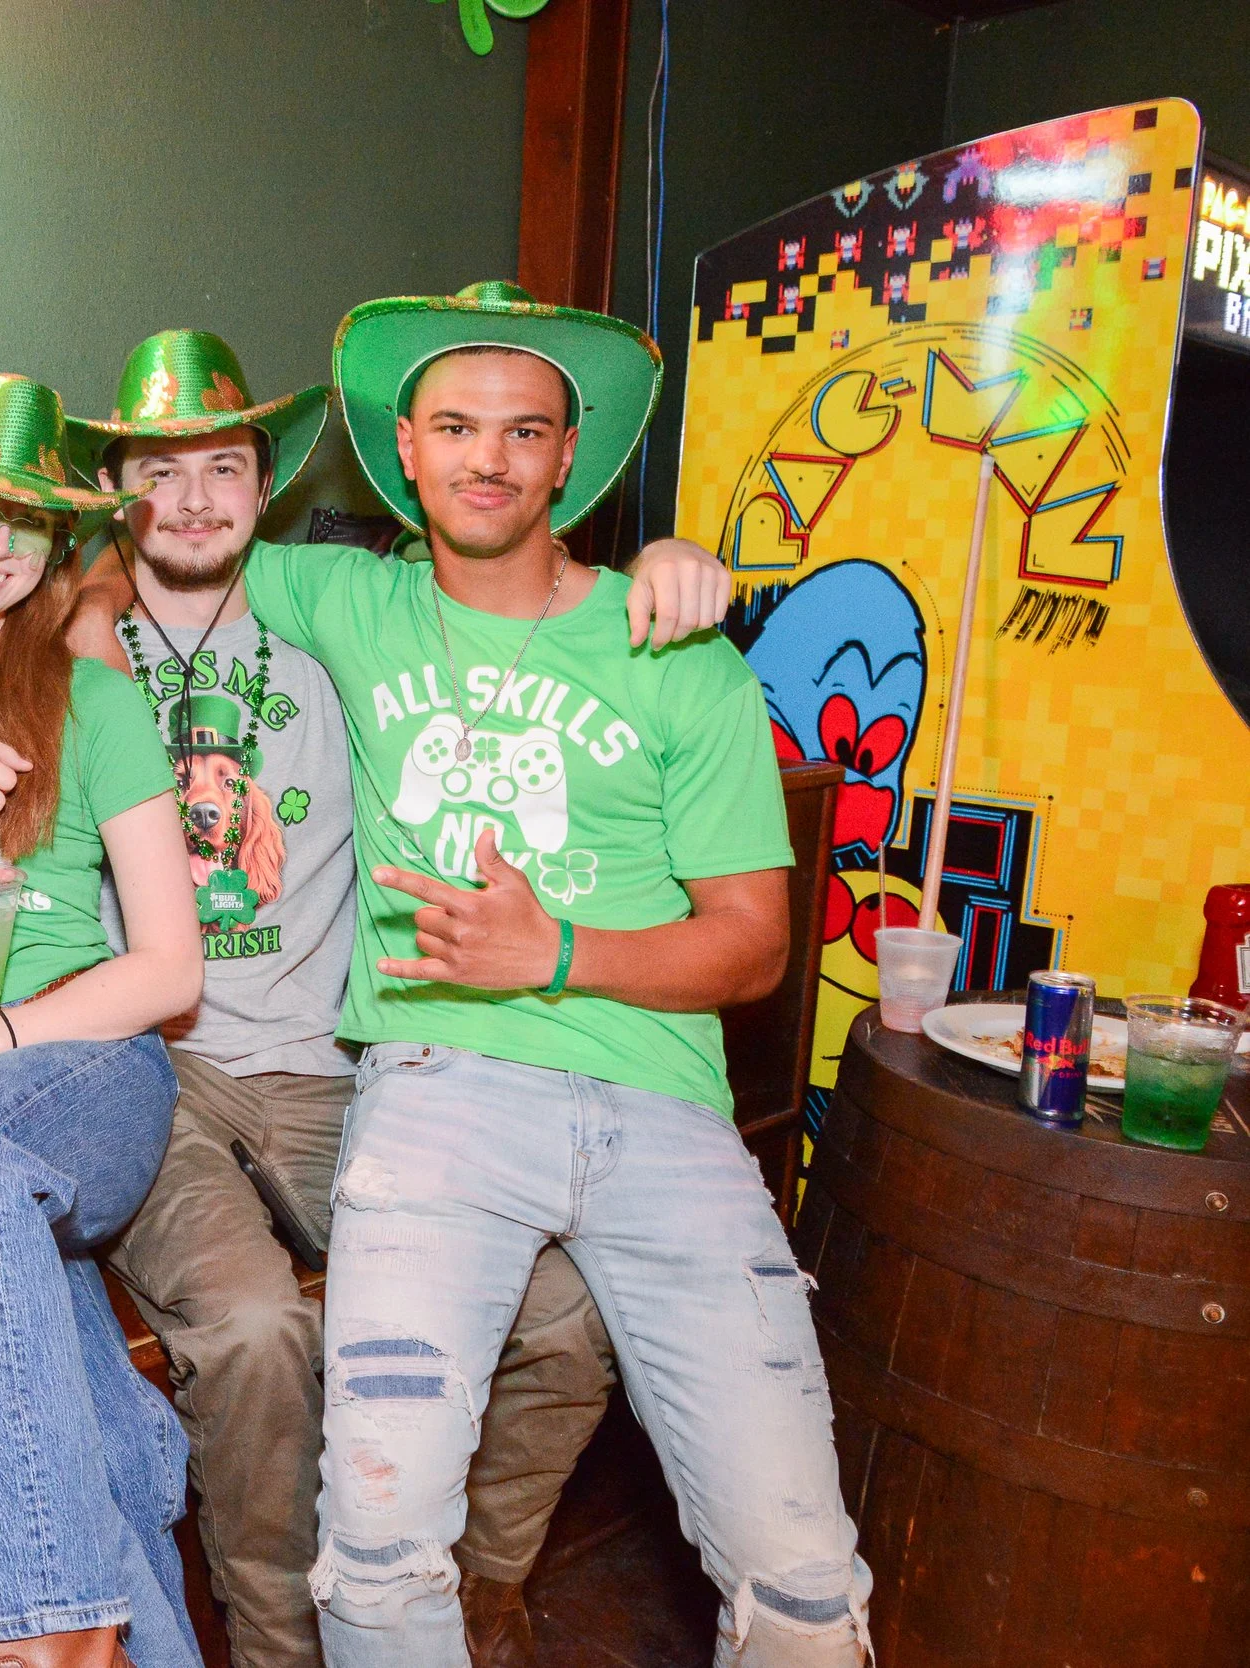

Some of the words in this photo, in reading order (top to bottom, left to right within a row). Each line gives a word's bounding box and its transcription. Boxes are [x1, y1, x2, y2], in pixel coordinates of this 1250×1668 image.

[1201, 176, 1250, 237] PAC-
[1193, 219, 1250, 297] PIX
[732, 347, 1125, 589] PAC-MAN
[134, 650, 218, 710] ISS
[223, 656, 300, 731] ME
[372, 664, 452, 733] ALL
[466, 664, 640, 768] SKILLS
[215, 901, 240, 909] LIGHT
[218, 894, 237, 902] BUD
[203, 924, 281, 959] RISH
[1025, 1031, 1057, 1053] Red
[1059, 1037, 1089, 1055] Bul
